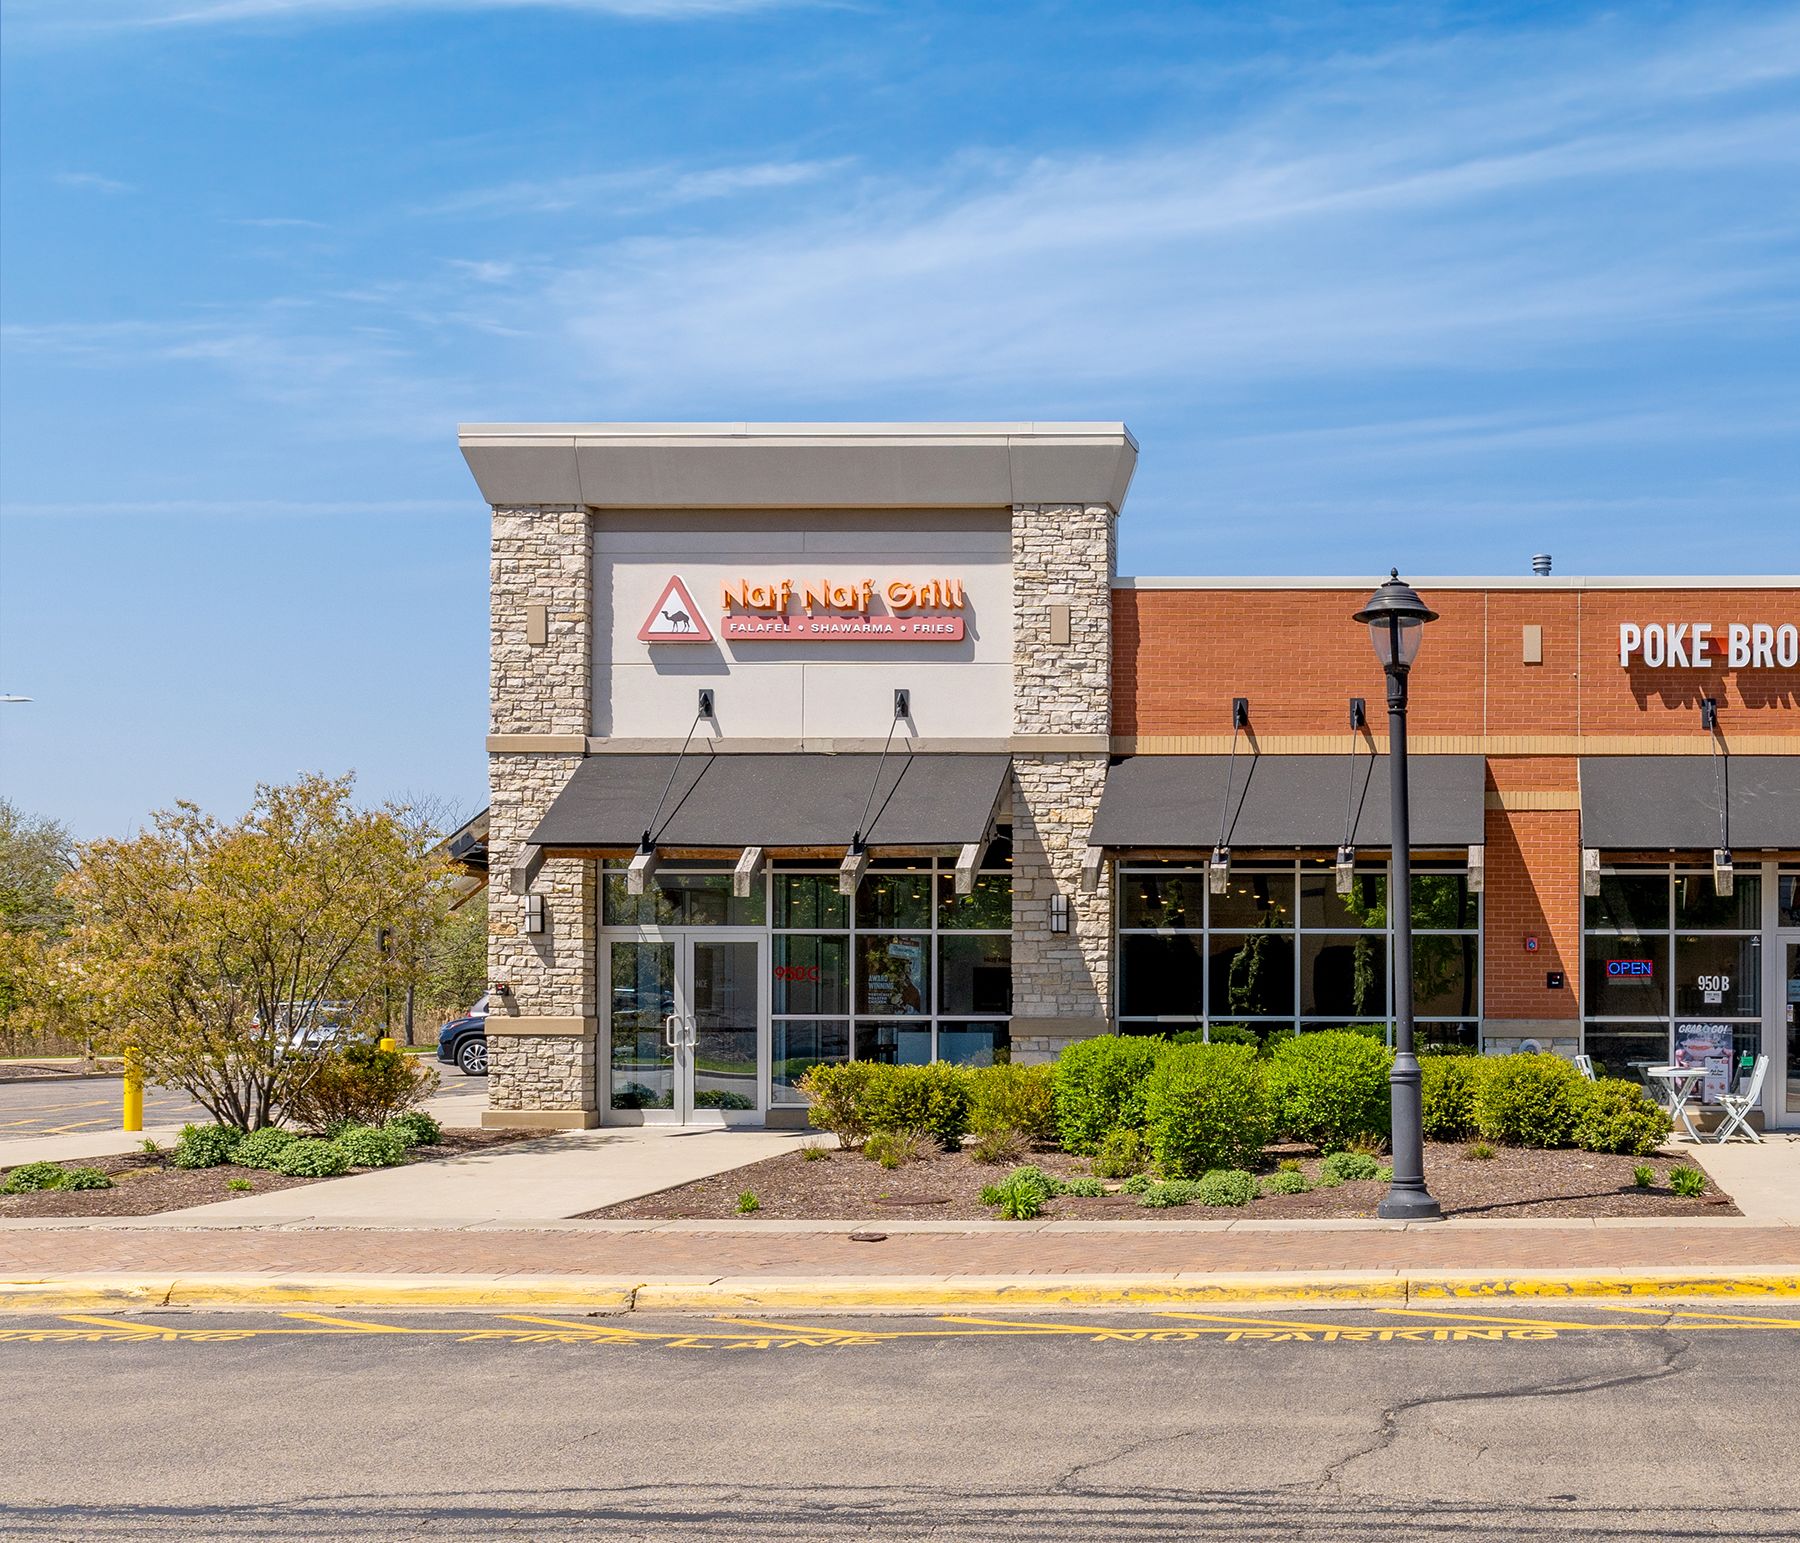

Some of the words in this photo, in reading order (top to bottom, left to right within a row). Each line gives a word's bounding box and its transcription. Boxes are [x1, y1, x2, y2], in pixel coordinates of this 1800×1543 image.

[720, 578, 795, 612] Naf
[801, 578, 875, 615] Naf
[888, 578, 965, 609] Grill
[730, 623, 791, 634] FALAFEL
[811, 623, 893, 634] SHAWARMA
[913, 623, 955, 634] FRIES
[1619, 623, 1712, 668] POKE
[1608, 962, 1651, 975] OPEN
[1678, 1024, 1701, 1033] GRAB
[1711, 1024, 1728, 1034] GO!
[1090, 1331, 1199, 1342] NO
[1224, 1328, 1558, 1342] PARKING
